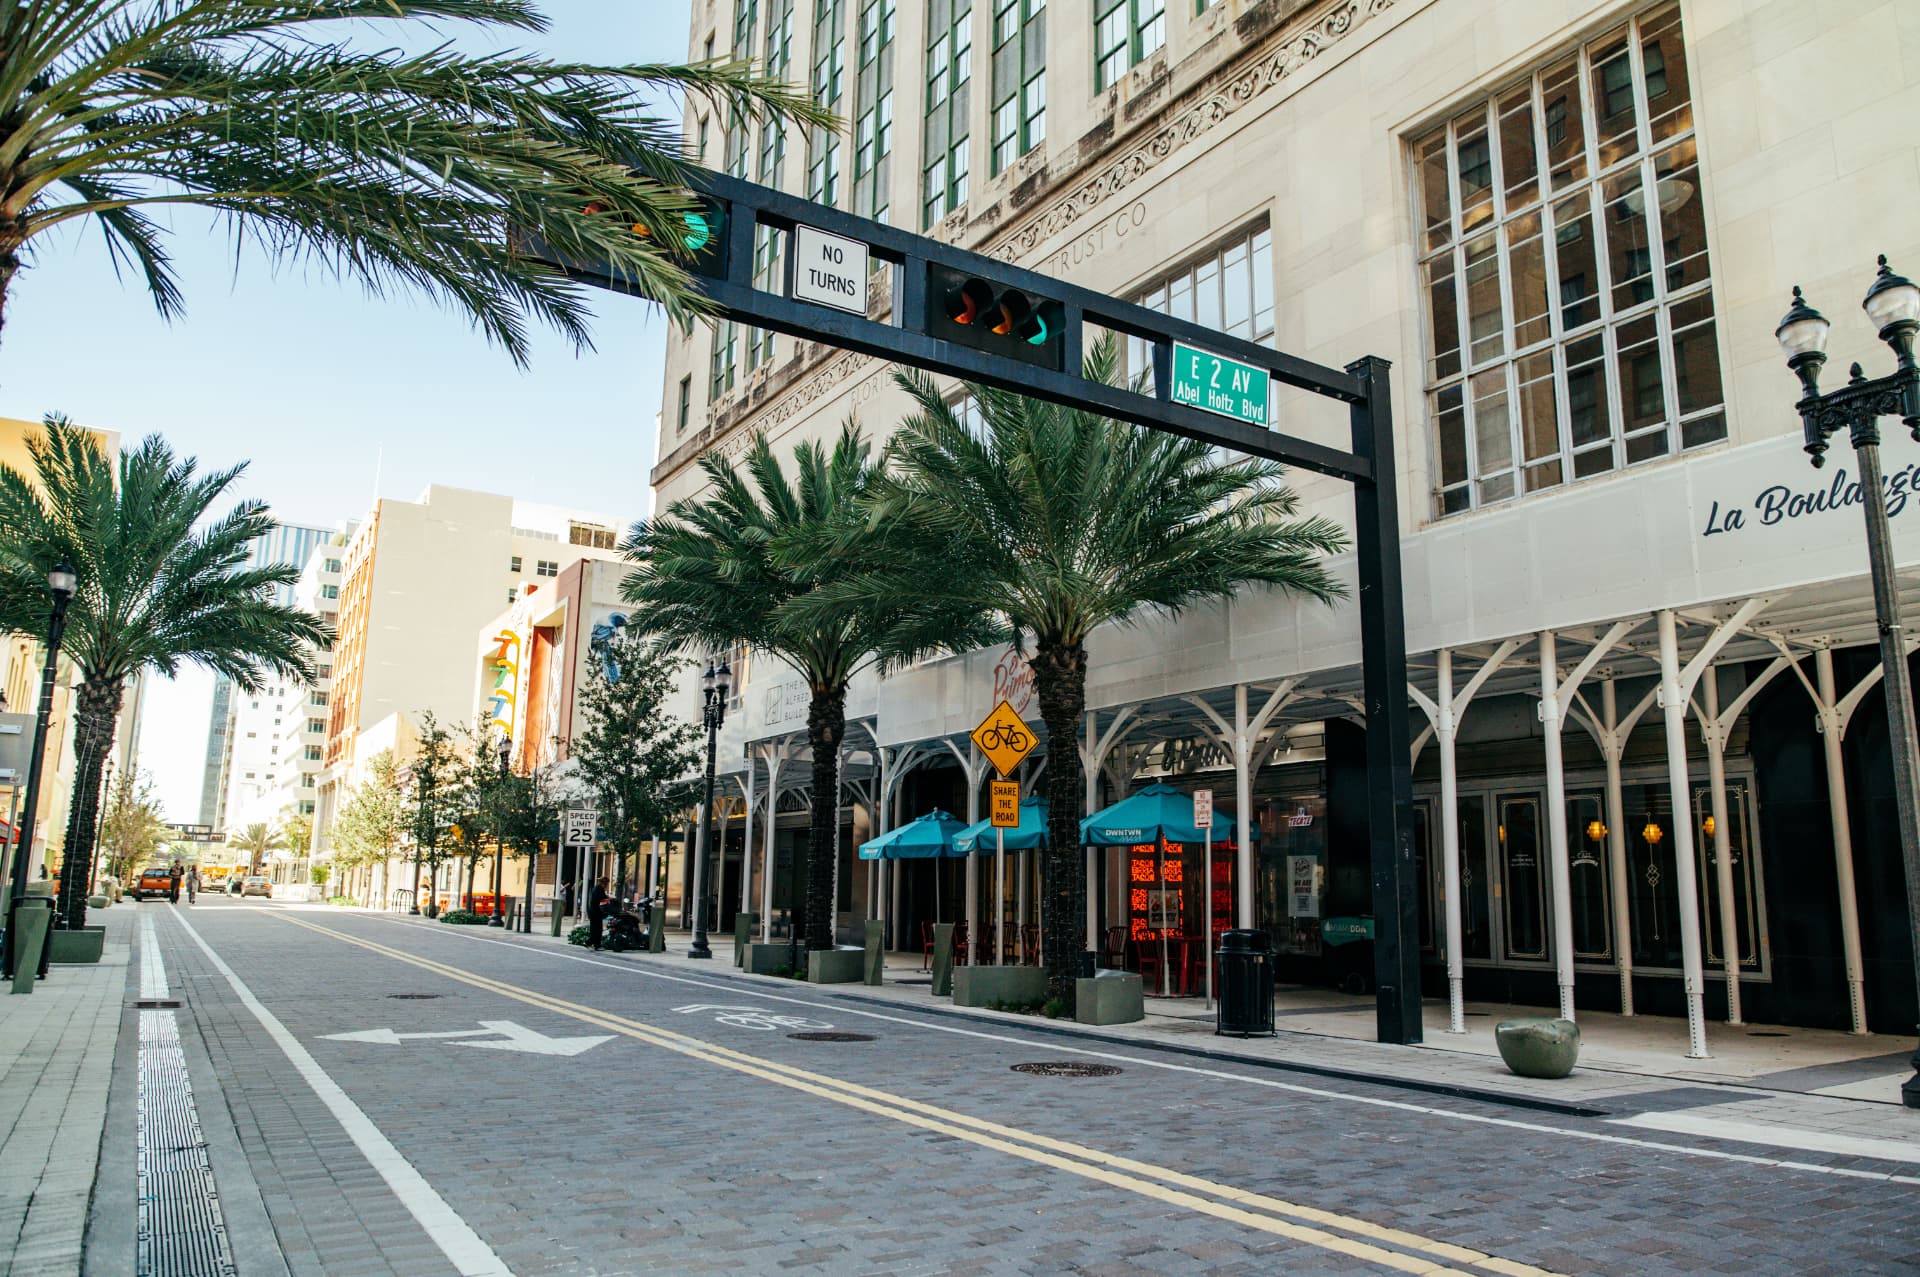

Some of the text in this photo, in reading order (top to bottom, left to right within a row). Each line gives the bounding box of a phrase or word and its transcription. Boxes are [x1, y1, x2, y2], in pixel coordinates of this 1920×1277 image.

[1048, 202, 1146, 277] TRUST CO
[823, 244, 843, 265] NO
[809, 268, 856, 297] TURNS
[850, 366, 893, 405] FLORID
[1191, 355, 1251, 395] E 2 AV
[1176, 380, 1264, 420] Abel Holtz Blvd
[1703, 500, 1746, 537] La
[993, 786, 1017, 796] SHARE
[570, 812, 595, 820] SPEED
[999, 799, 1012, 809] THE
[995, 812, 1015, 822] ROAD
[569, 828, 593, 842] 25
